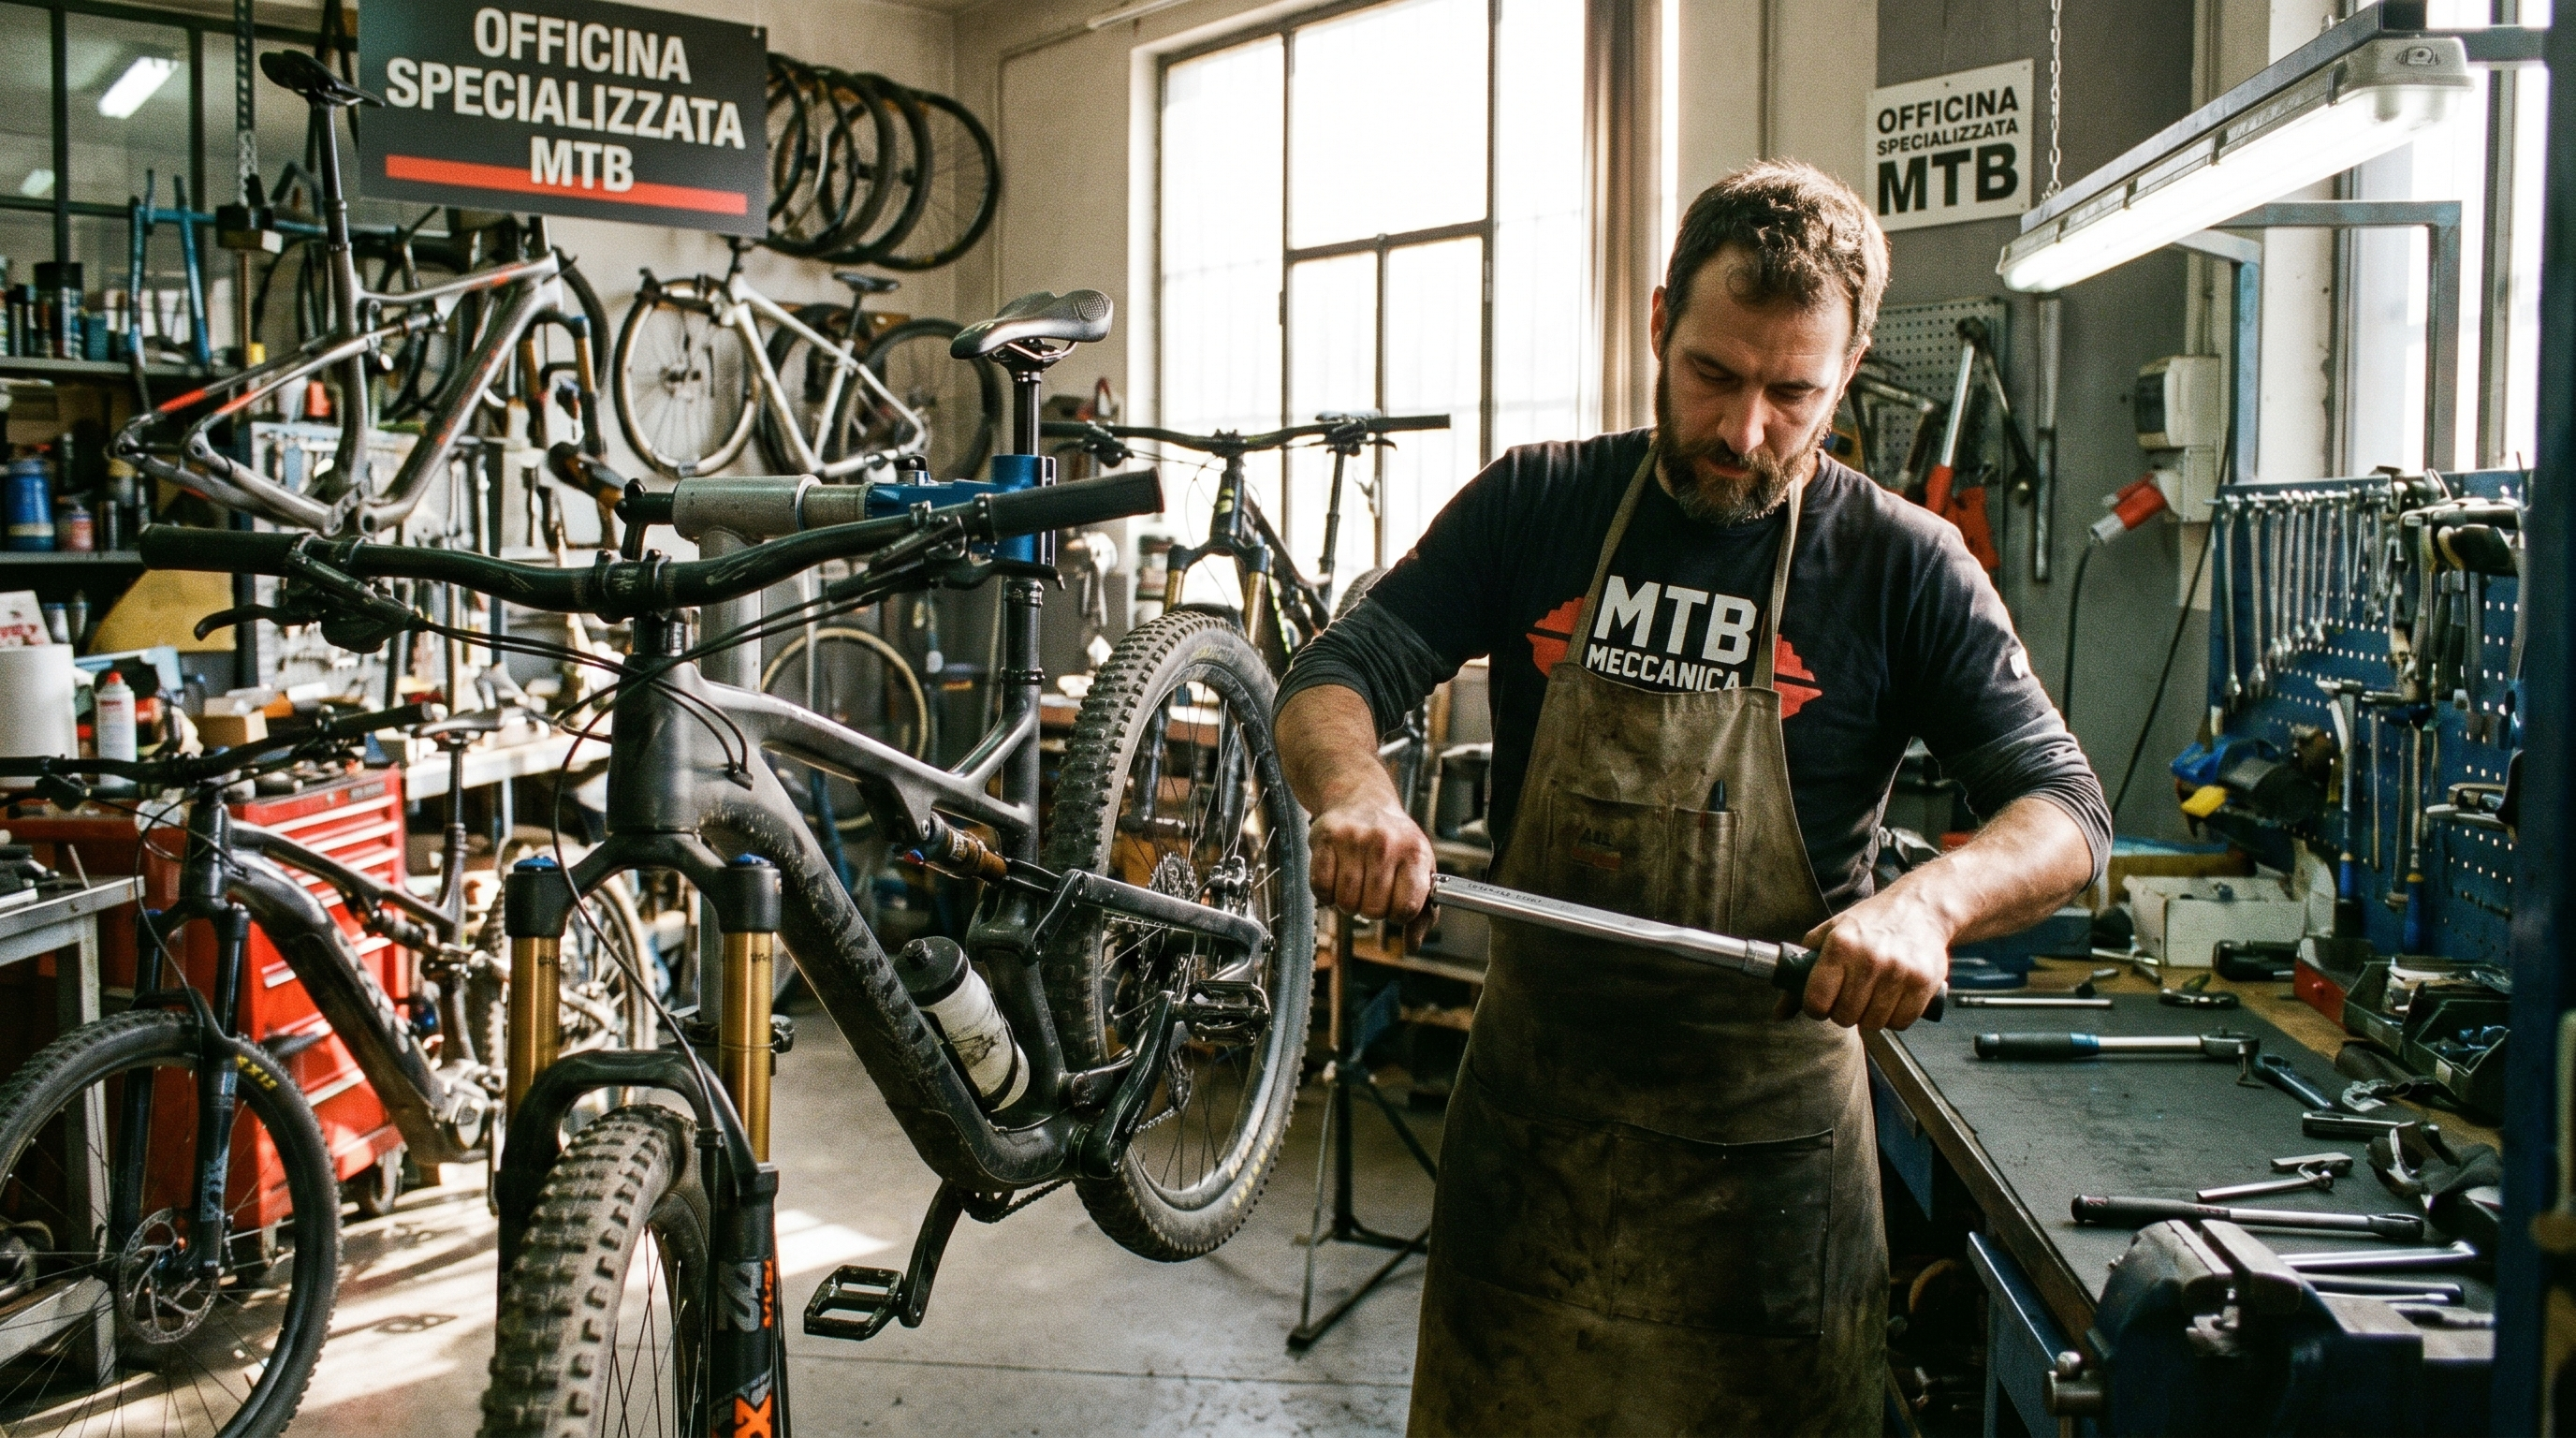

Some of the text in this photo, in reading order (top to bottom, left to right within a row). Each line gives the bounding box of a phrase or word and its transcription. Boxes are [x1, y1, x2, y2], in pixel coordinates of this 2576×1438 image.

[474, 7, 692, 84] OFFICINA
[386, 57, 746, 150] SPECIALIZZATA
[1877, 85, 2019, 134] OFFICINA
[530, 136, 634, 192] MTB
[1877, 118, 2019, 156] SPECIALIZZATA
[1878, 142, 2018, 216] MTB
[1593, 575, 1757, 665] MTB
[1586, 643, 1740, 692] MECCANICA
